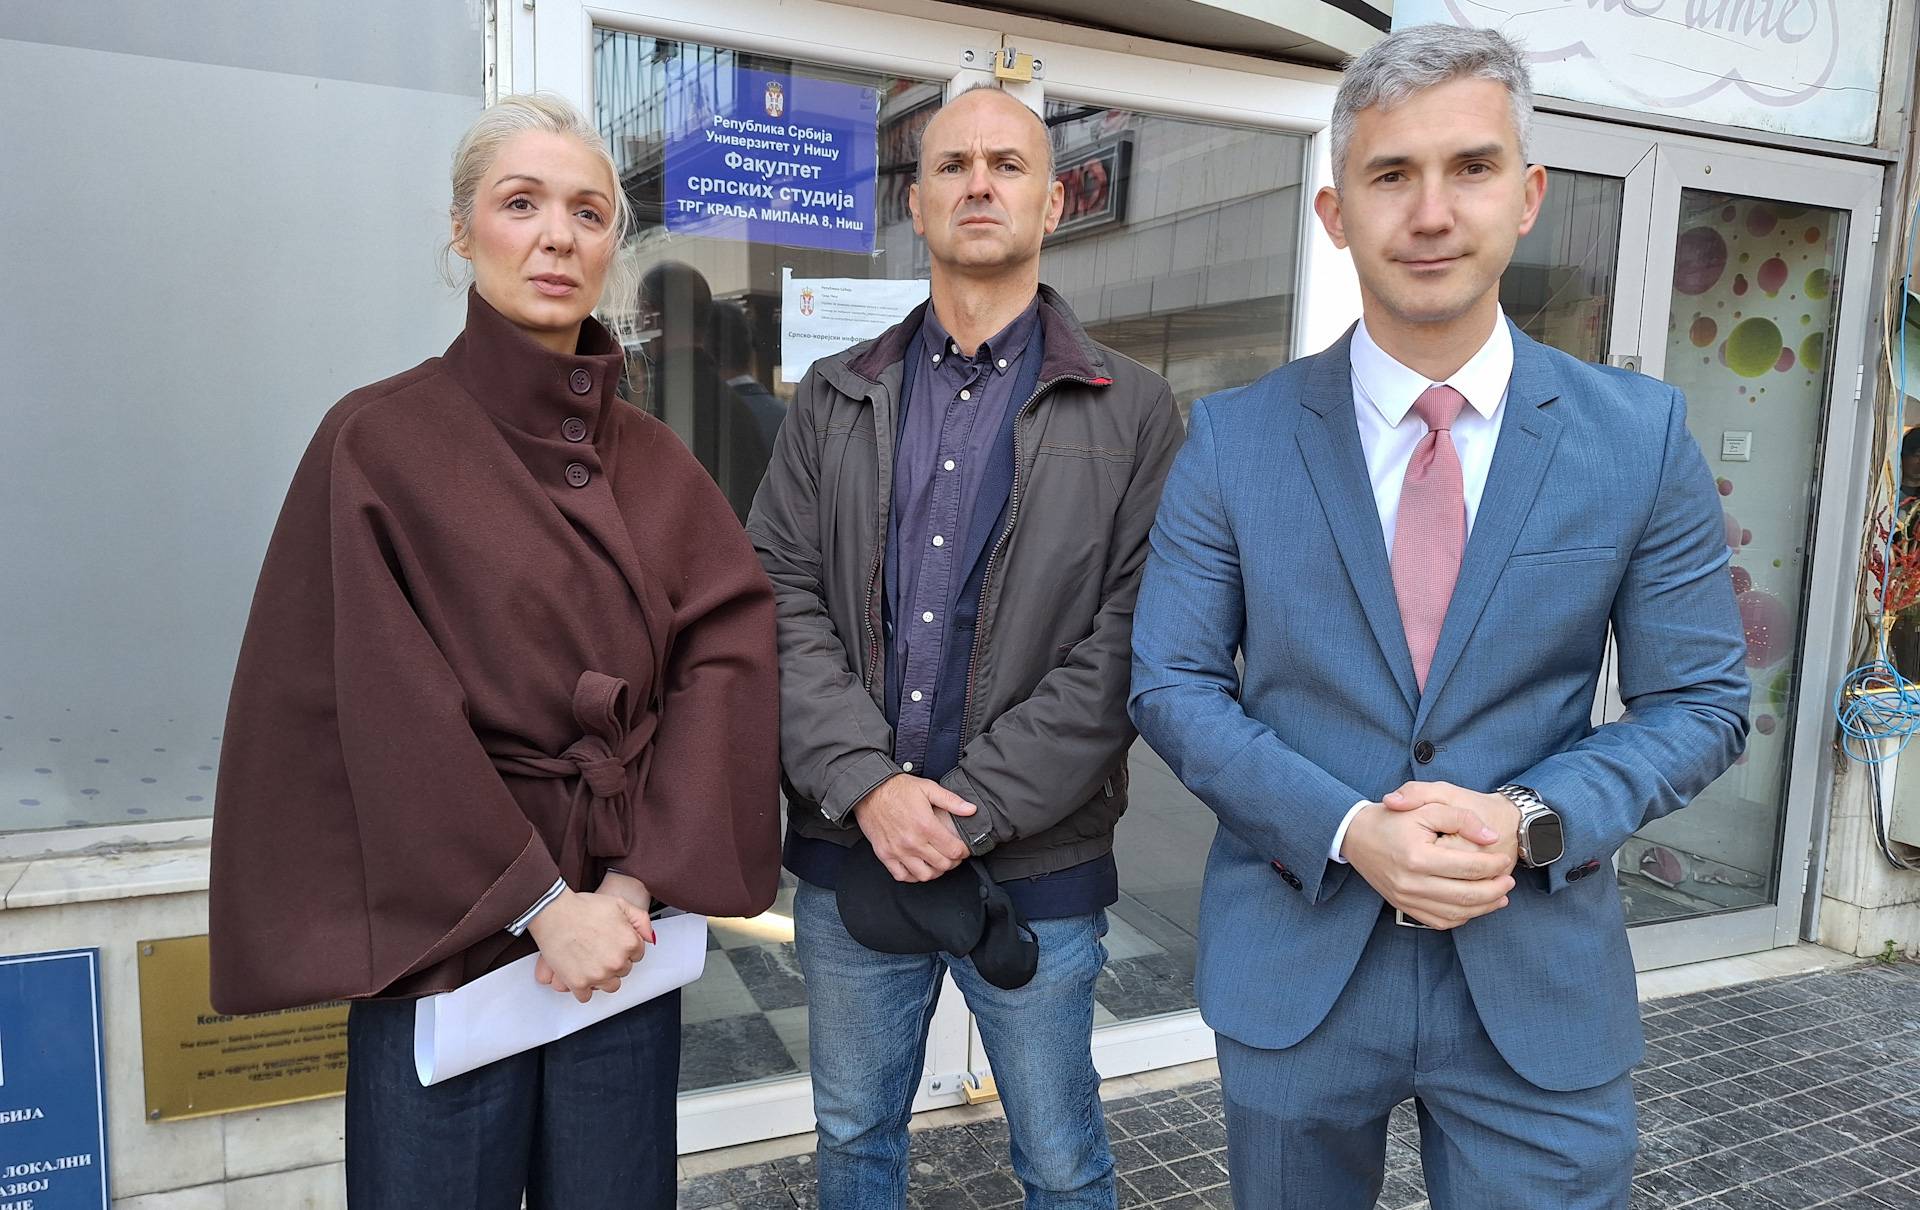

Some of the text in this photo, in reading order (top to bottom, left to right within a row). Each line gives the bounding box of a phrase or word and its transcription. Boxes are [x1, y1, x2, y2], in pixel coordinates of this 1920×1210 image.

[713, 115, 833, 143] Република Србија
[705, 130, 839, 161] Универзитет у Нишу
[724, 151, 821, 180] Факултет
[687, 175, 854, 212] српских студија
[677, 199, 864, 231] ТРГ КРАЉА МИЛАНА 8, Ниш
[2, 1154, 92, 1179] ЛОКАЛНИ
